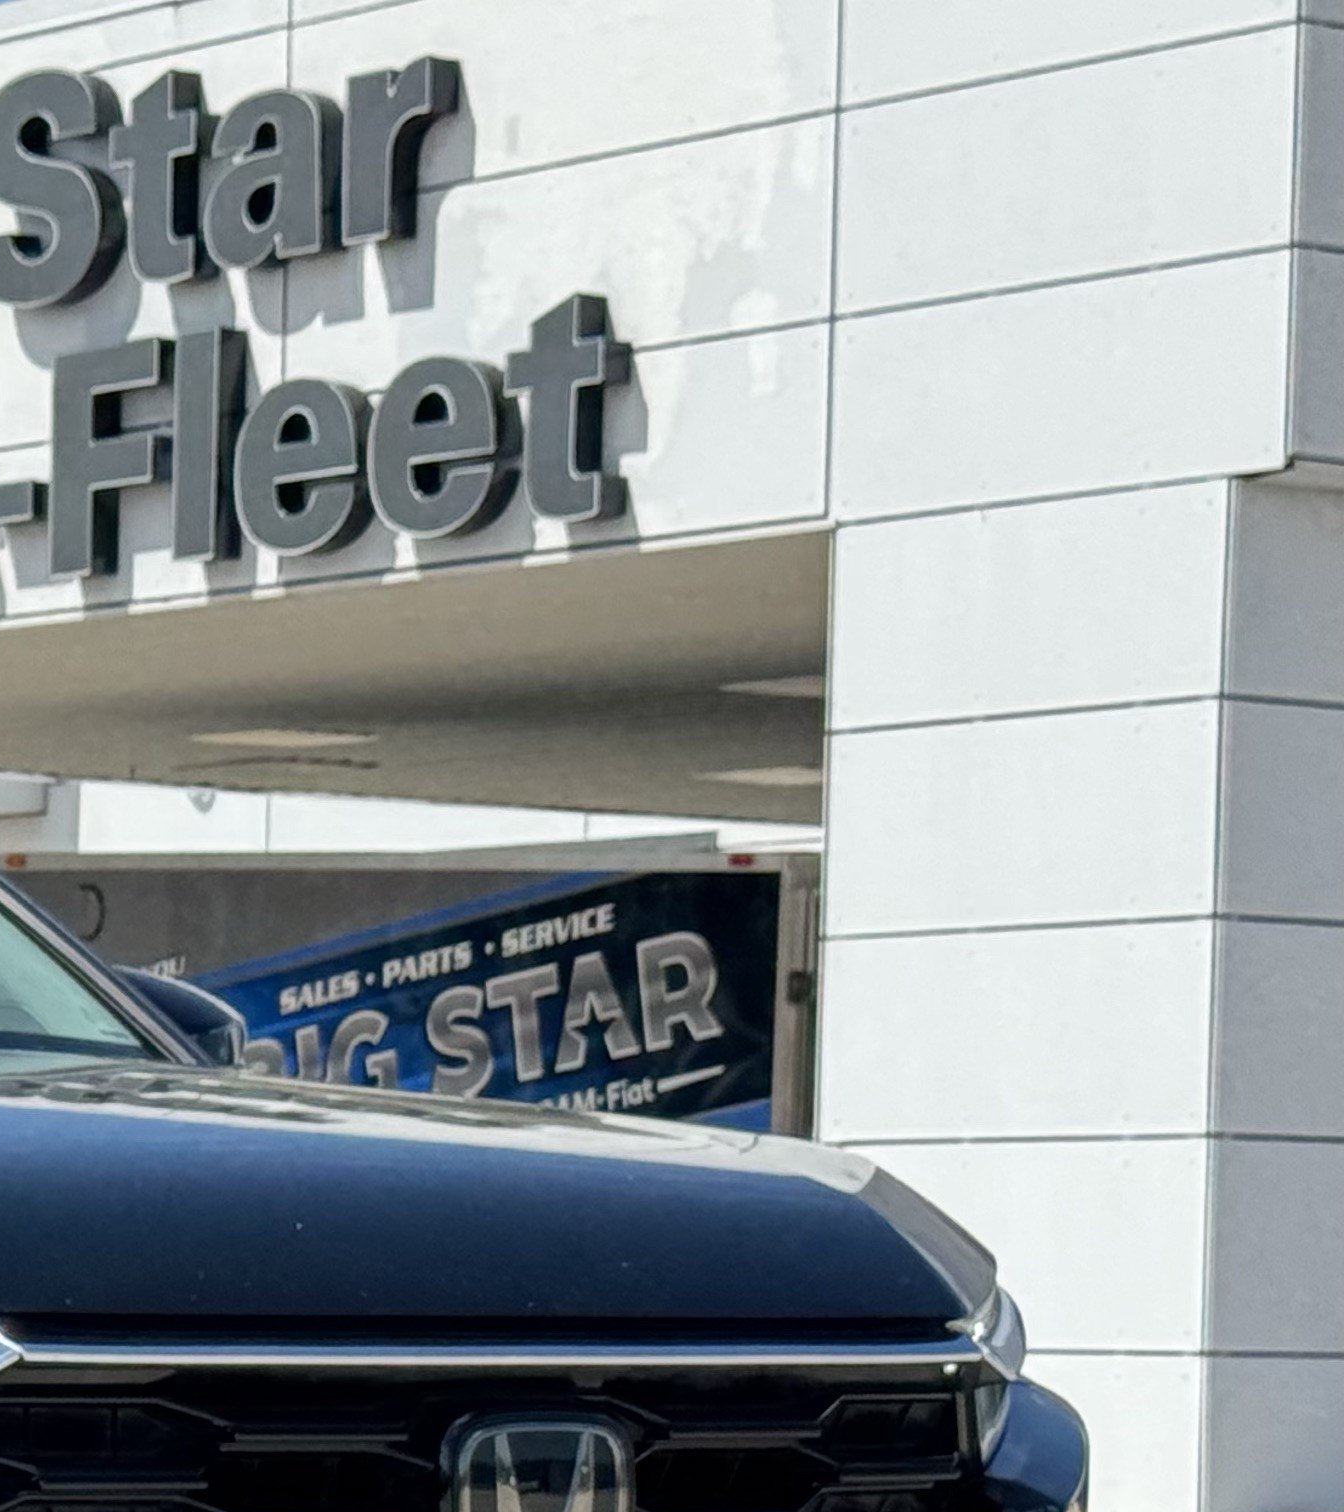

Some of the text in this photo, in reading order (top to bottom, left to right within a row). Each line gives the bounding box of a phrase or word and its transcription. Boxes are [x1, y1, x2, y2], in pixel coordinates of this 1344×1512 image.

[279, 903, 616, 1016] SALES PARTS SERVICE
[427, 931, 725, 1100] STAR
[607, 1077, 658, 1111] Fiat
